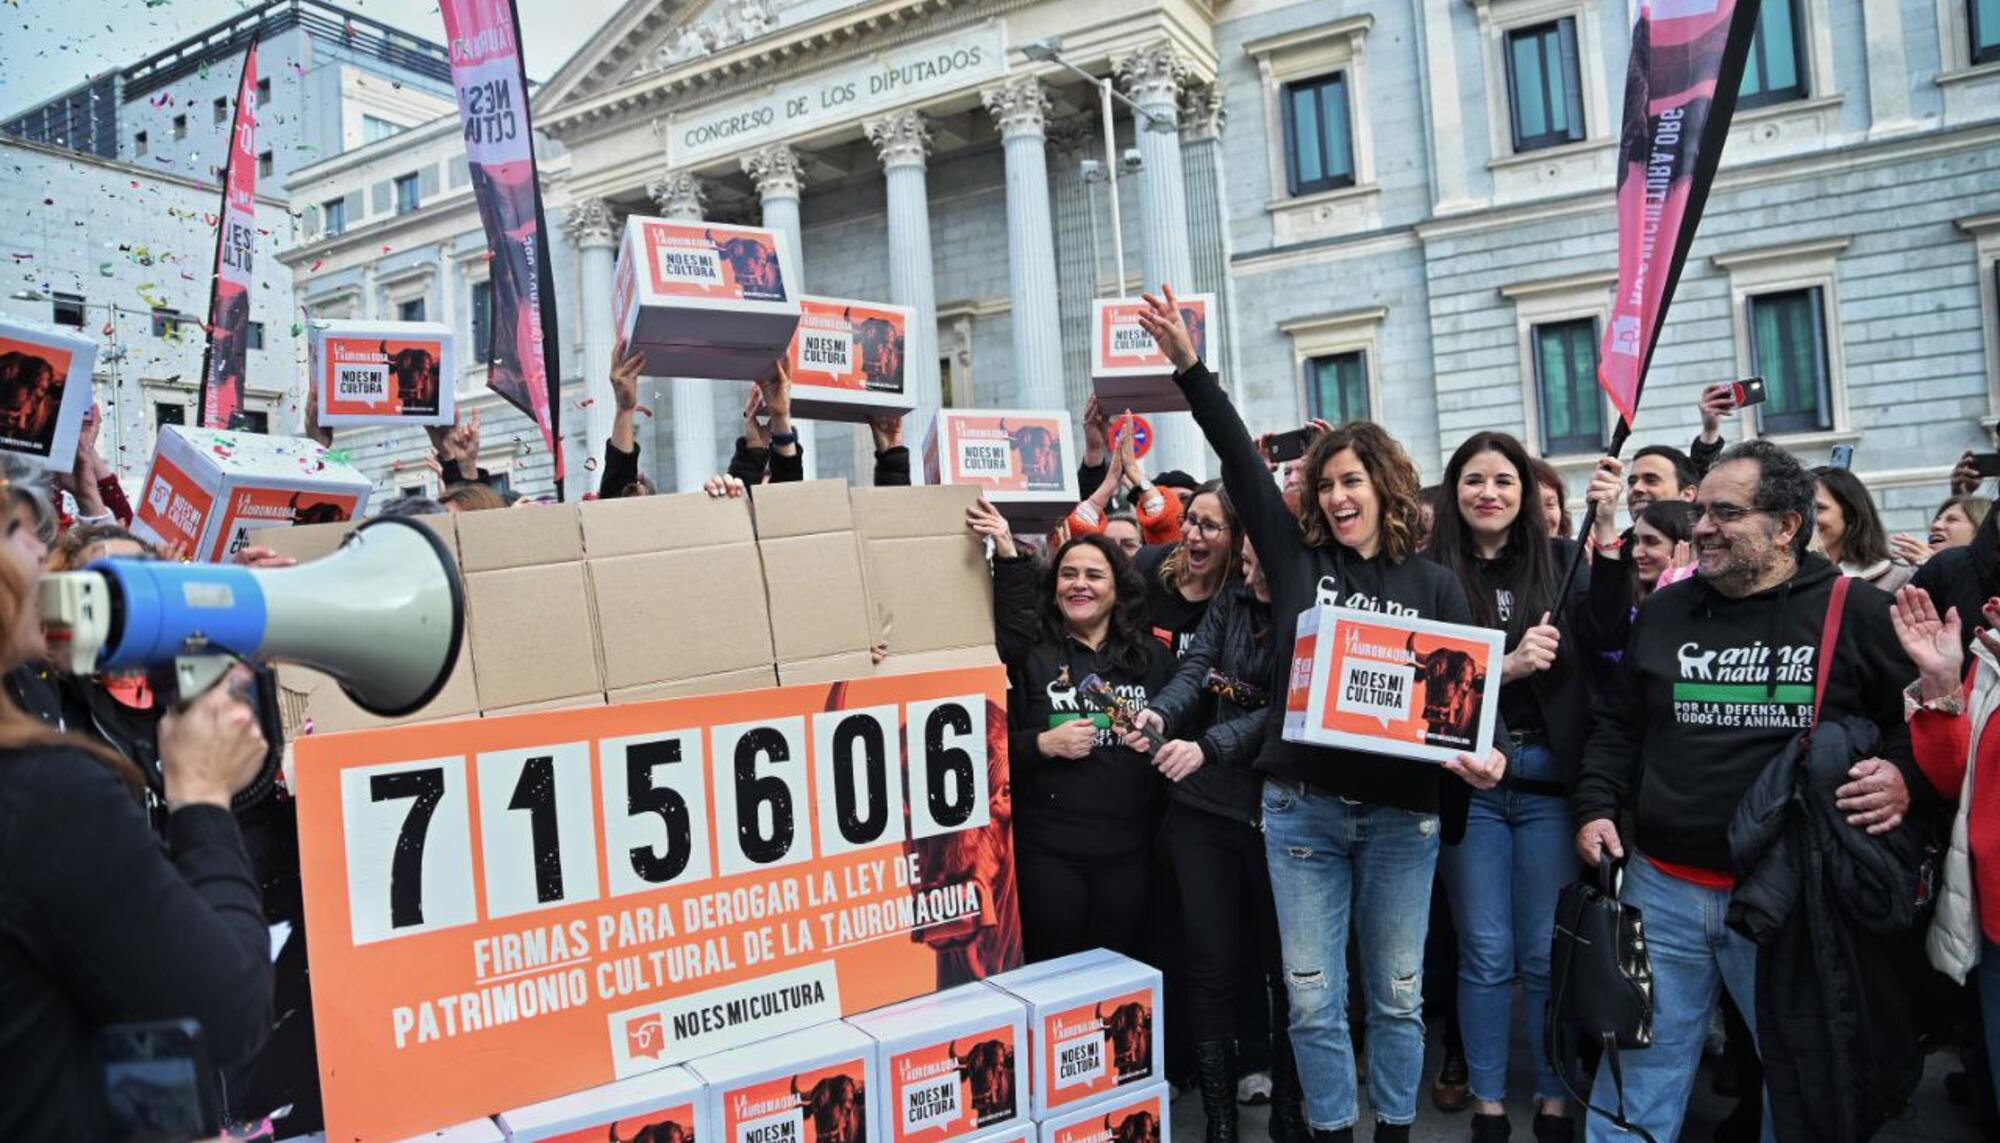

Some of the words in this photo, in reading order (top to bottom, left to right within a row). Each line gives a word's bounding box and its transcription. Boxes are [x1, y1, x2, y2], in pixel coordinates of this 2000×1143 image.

[685, 107, 773, 148] CONGRESO
[786, 95, 809, 119] DE
[820, 83, 856, 108] LOS
[870, 46, 981, 95] DIPUTADOS
[666, 265, 716, 278] CULTURA
[804, 349, 846, 365] CULTURA
[340, 382, 382, 394] CULTURA
[965, 457, 1006, 470] CULTURA
[1345, 627, 1360, 643] LA
[1346, 686, 1403, 709] CULTURA
[1674, 702, 1699, 712] POR
[1704, 703, 1719, 713] LA
[1725, 704, 1786, 716] DEFENSA
[1797, 705, 1814, 716] DE
[1676, 712, 1713, 724] TODOS
[1717, 714, 1741, 726] LOS
[1744, 716, 1815, 728] ANIMALES
[473, 919, 590, 978] FIRMAS
[597, 902, 675, 952] PARA
[683, 877, 799, 934] DEROGAR
[806, 870, 837, 907] LA
[844, 861, 885, 899] LEY
[893, 853, 921, 888] DE
[392, 968, 588, 1049] PATRIMONIO
[596, 936, 736, 1000] CULTURAL
[743, 925, 775, 966] DE
[781, 918, 815, 957] LA
[820, 881, 980, 946] TAUROMAQUIA
[1060, 1057, 1100, 1079] CULTURA
[909, 1098, 956, 1122] CULTURA
